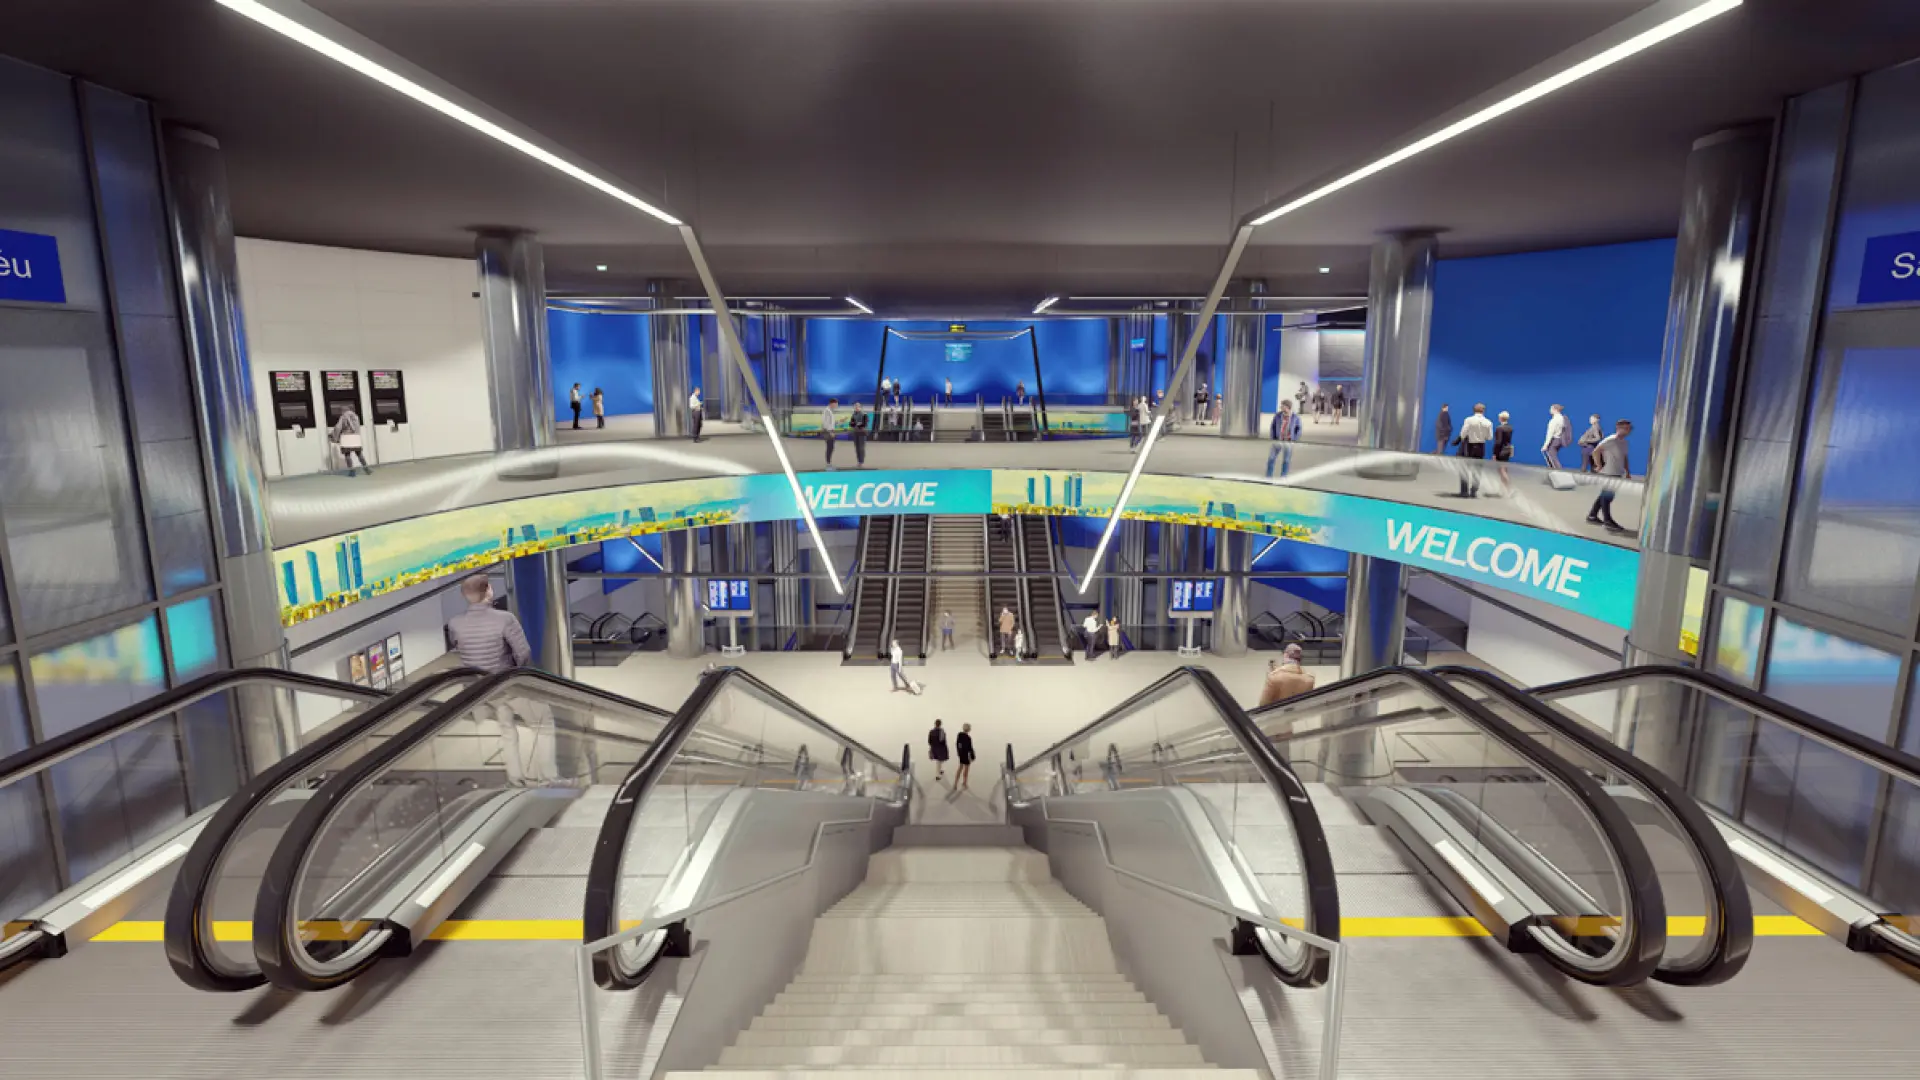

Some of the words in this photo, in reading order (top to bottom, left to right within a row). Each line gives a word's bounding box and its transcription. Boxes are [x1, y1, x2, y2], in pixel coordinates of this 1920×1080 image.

[1891, 252, 1920, 279] S
[797, 482, 938, 510] WELCOME
[1386, 518, 1589, 598] WELCOME
